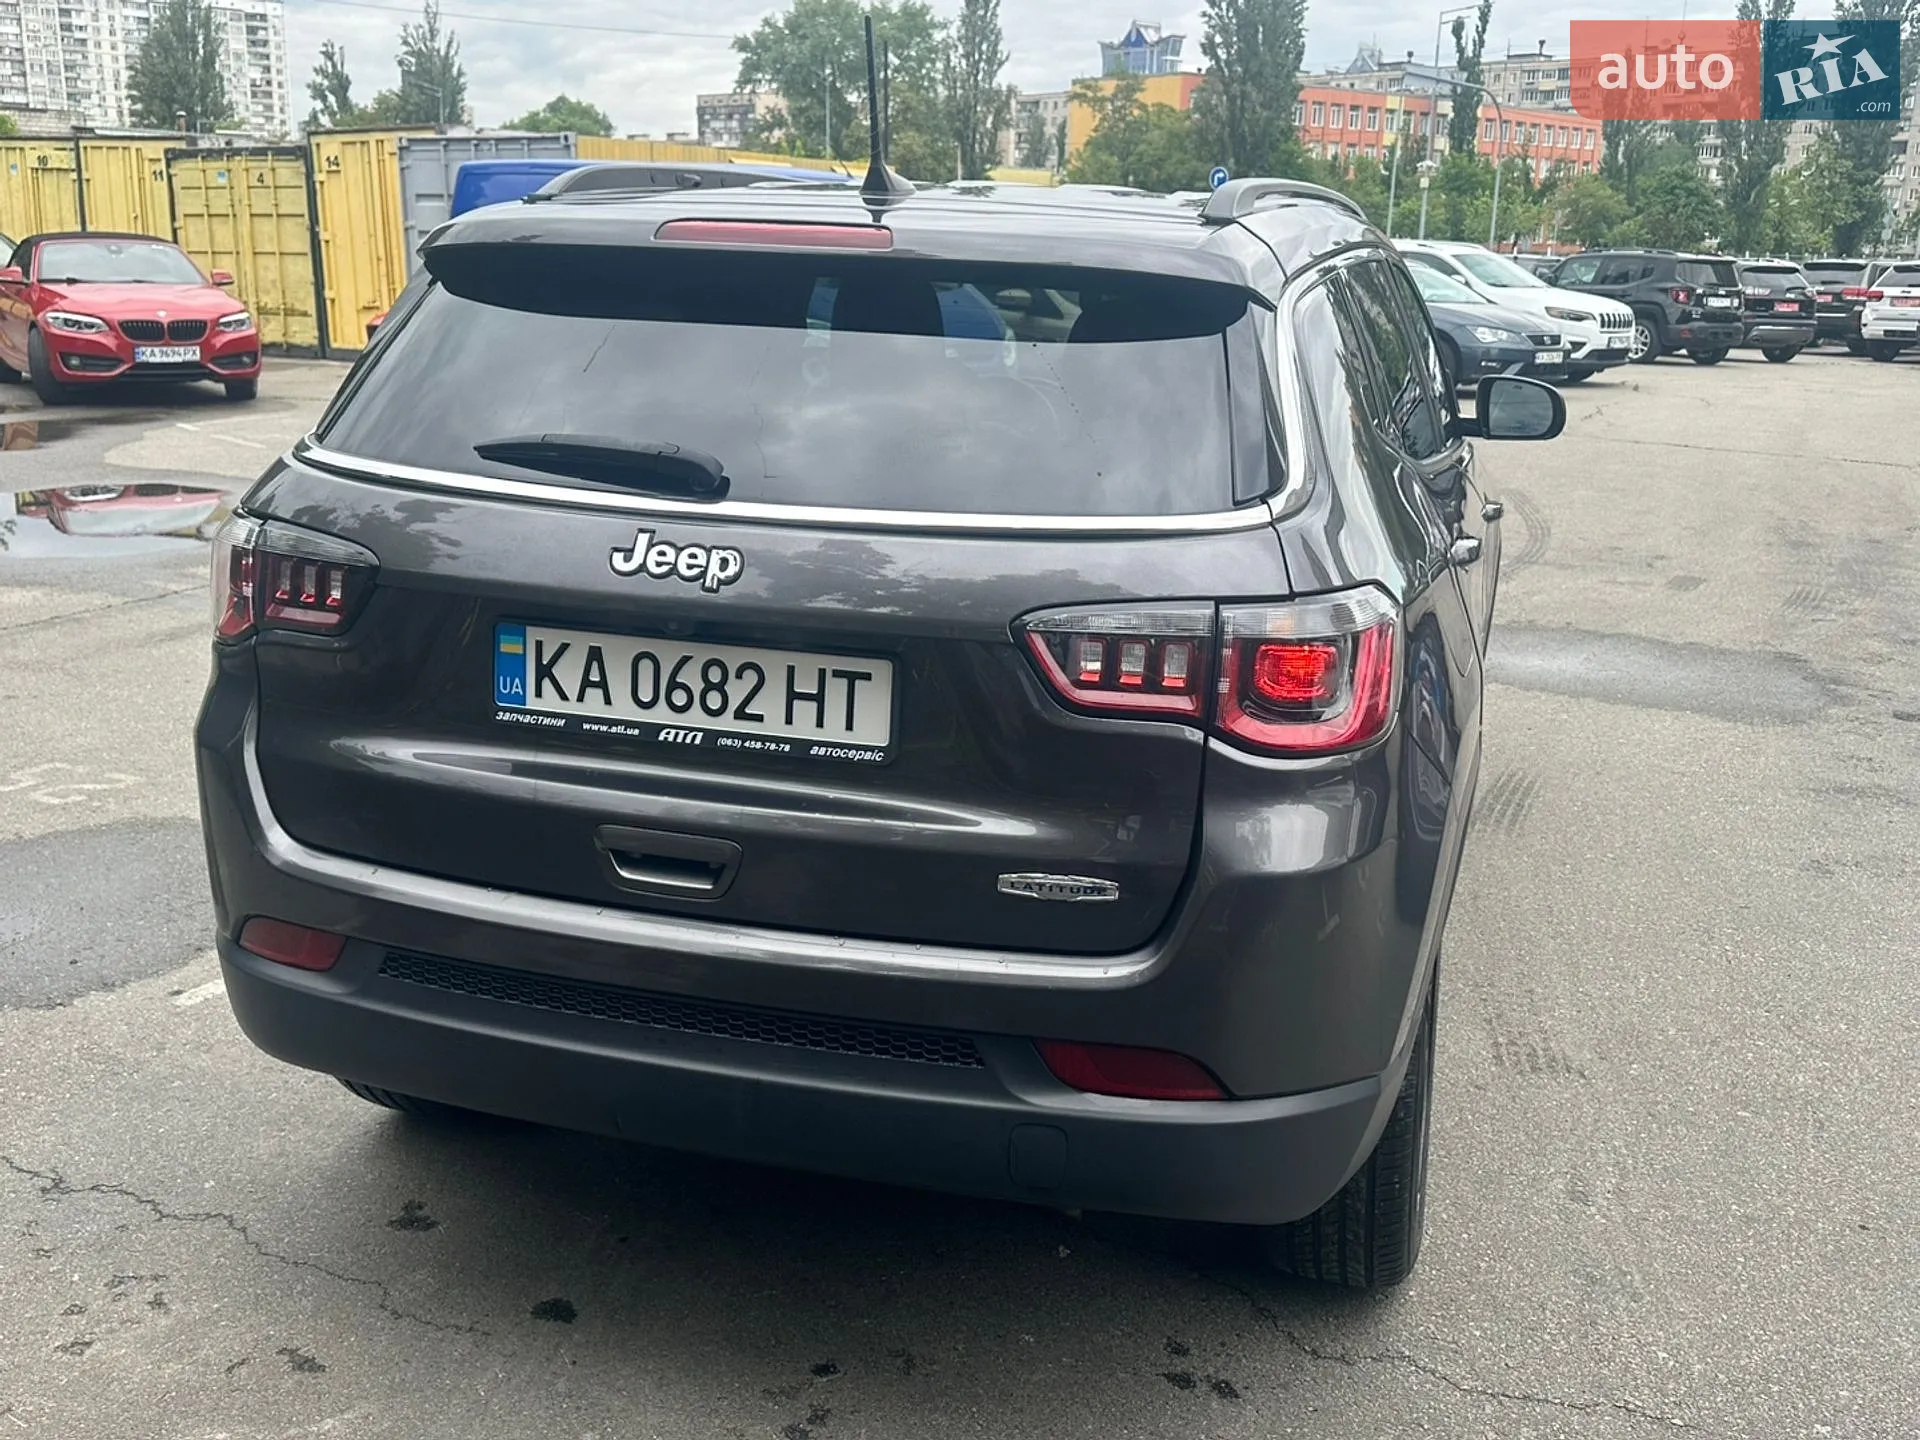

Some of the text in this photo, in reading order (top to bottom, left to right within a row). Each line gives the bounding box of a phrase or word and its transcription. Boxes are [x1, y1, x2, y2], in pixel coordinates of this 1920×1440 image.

[36, 154, 49, 167] 10
[325, 154, 341, 169] 14
[152, 169, 164, 182] 11
[256, 171, 265, 185] 4
[141, 348, 157, 358] KA
[609, 528, 744, 593] Jeep
[499, 675, 524, 698] UA
[533, 638, 874, 732] KA 0682 HT
[495, 710, 567, 728] запчастини
[716, 736, 791, 753] (063) 458-78-78
[809, 744, 885, 763] автосервіс
[1009, 880, 1108, 896] LATITUDE
